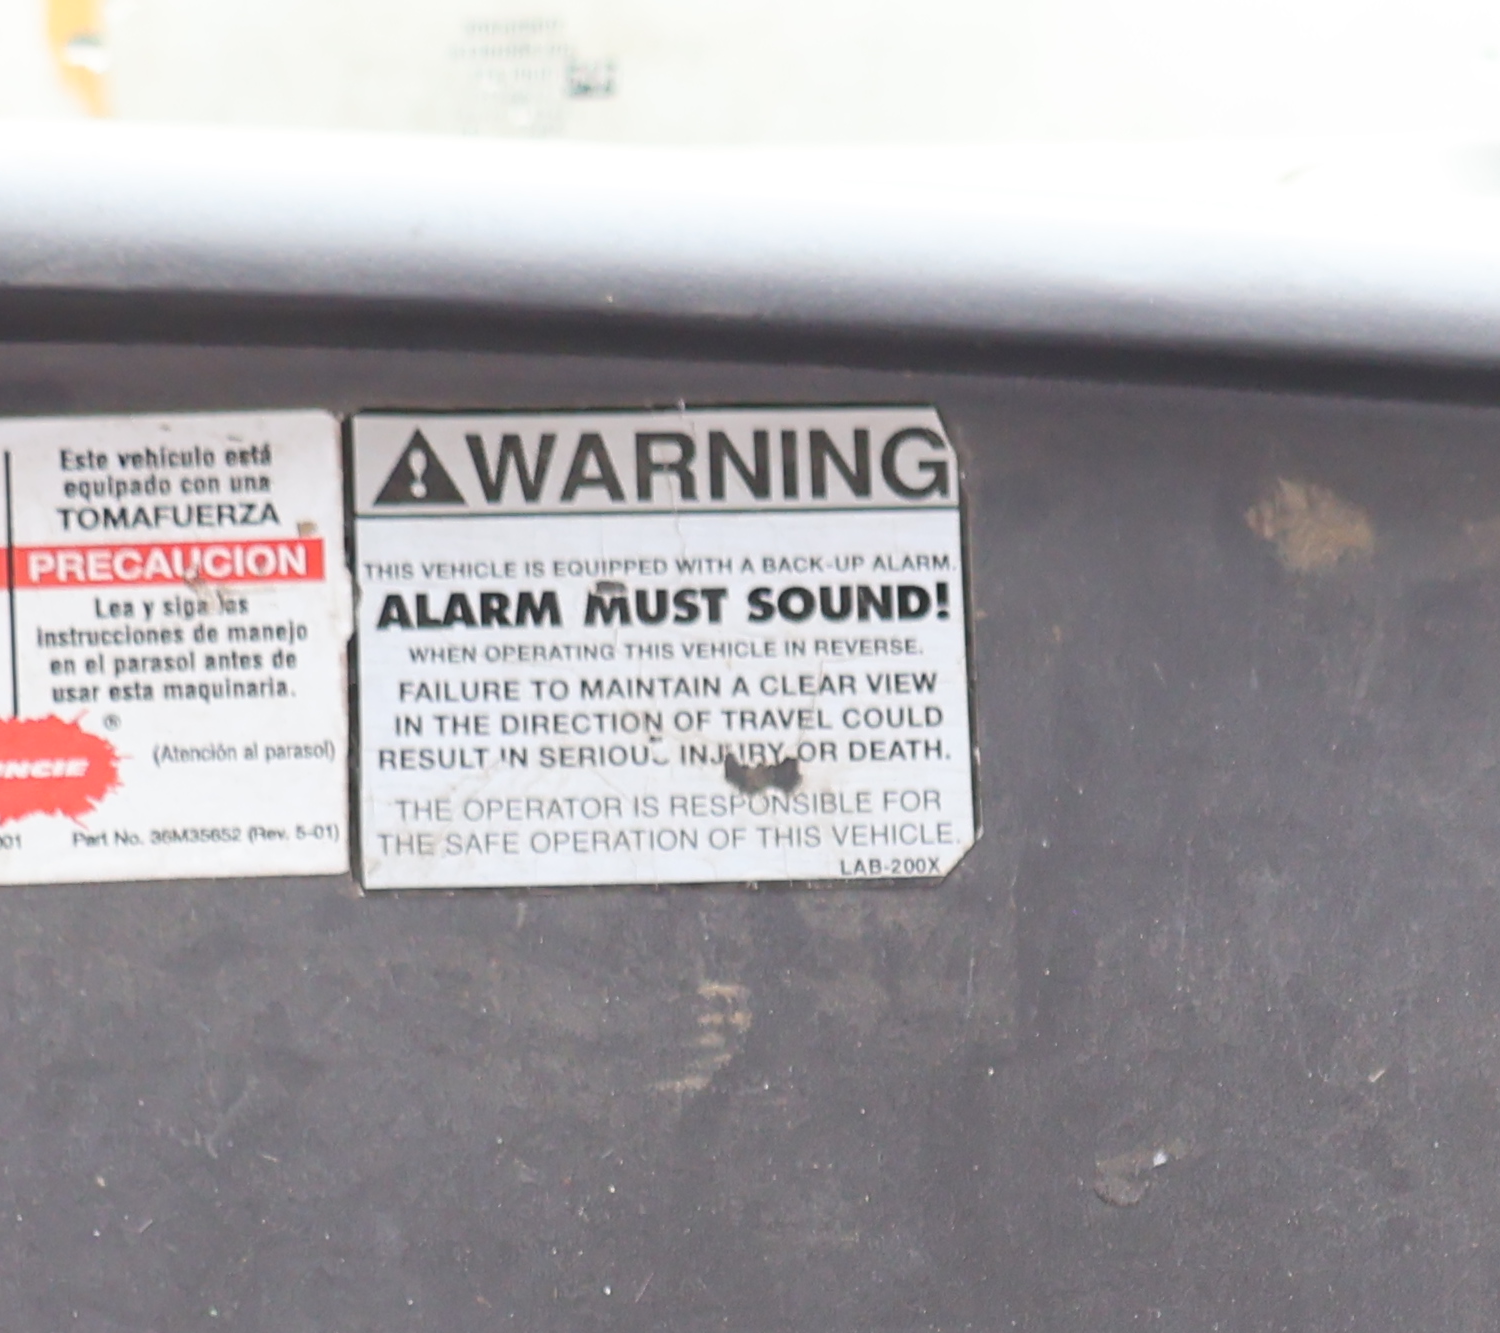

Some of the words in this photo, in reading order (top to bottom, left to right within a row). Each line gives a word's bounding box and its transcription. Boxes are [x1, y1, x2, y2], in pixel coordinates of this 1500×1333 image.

[60, 447, 107, 471] Este
[465, 426, 951, 504] WARNING
[63, 474, 172, 500] equipado
[180, 476, 220, 495] con
[230, 474, 271, 493] una
[56, 502, 281, 532] TOMAFUERZA
[26, 544, 308, 584] PRECAUCION
[363, 562, 415, 581] THIS
[421, 560, 518, 579] VEHICLE
[524, 560, 546, 578] IS
[553, 557, 668, 577] EQUIPPED
[675, 557, 733, 576] WITH
[740, 556, 756, 575] A
[762, 555, 865, 575] BACK-UP
[872, 554, 958, 573] ALARM.
[94, 596, 135, 619] Lea
[143, 600, 154, 622] y
[162, 596, 208, 621] siga
[376, 590, 563, 631] ALARM
[583, 587, 728, 627] MUST
[747, 581, 949, 625] SOUND!
[36, 626, 186, 649] instrucciones
[193, 621, 219, 644] de
[227, 619, 308, 646] manejo
[49, 656, 76, 676] en
[84, 653, 106, 675] el
[113, 651, 196, 678] parasol
[204, 650, 263, 671] antes
[271, 648, 297, 669] de
[409, 645, 476, 664] WHEN
[484, 642, 615, 663] OPERATING
[624, 641, 675, 661] THIS
[682, 640, 777, 660] VEHICLE
[785, 638, 808, 658] IN
[814, 637, 924, 658] REVERSE.
[51, 683, 101, 704] usar
[108, 679, 155, 702] esta
[163, 676, 297, 704] maquinaria.
[399, 680, 520, 703] FAILURE
[530, 679, 570, 701] TO
[580, 675, 722, 700] MAINTAIN
[732, 675, 750, 698] A
[759, 674, 857, 697] CLEAR
[865, 671, 938, 695] VIEW
[394, 714, 423, 737] IN
[433, 713, 491, 736] THE
[501, 710, 663, 736] DIRECTION
[673, 709, 712, 732] OF
[720, 707, 832, 731] TRAVEL
[842, 706, 943, 729] COULD
[152, 743, 237, 767] (Atención
[243, 742, 259, 762] al
[264, 739, 337, 763] parasol)
[378, 747, 490, 771] RESULT
[797, 741, 838, 764] OR
[848, 739, 951, 763] DEATH.
[395, 799, 451, 822] THE
[463, 797, 623, 822] OPERATOR
[634, 795, 660, 818] IS
[670, 790, 873, 818] RESPONSIBLE
[883, 789, 942, 812] FOR
[72, 831, 108, 848] Part
[113, 829, 145, 847] No.
[377, 833, 435, 856] THE
[445, 832, 520, 856] SAFE
[530, 829, 698, 854] OPERATION
[708, 827, 747, 850] OF
[757, 825, 822, 848] THIS
[831, 823, 961, 847] VEHICLE.
[840, 857, 941, 876] LAB-200X
